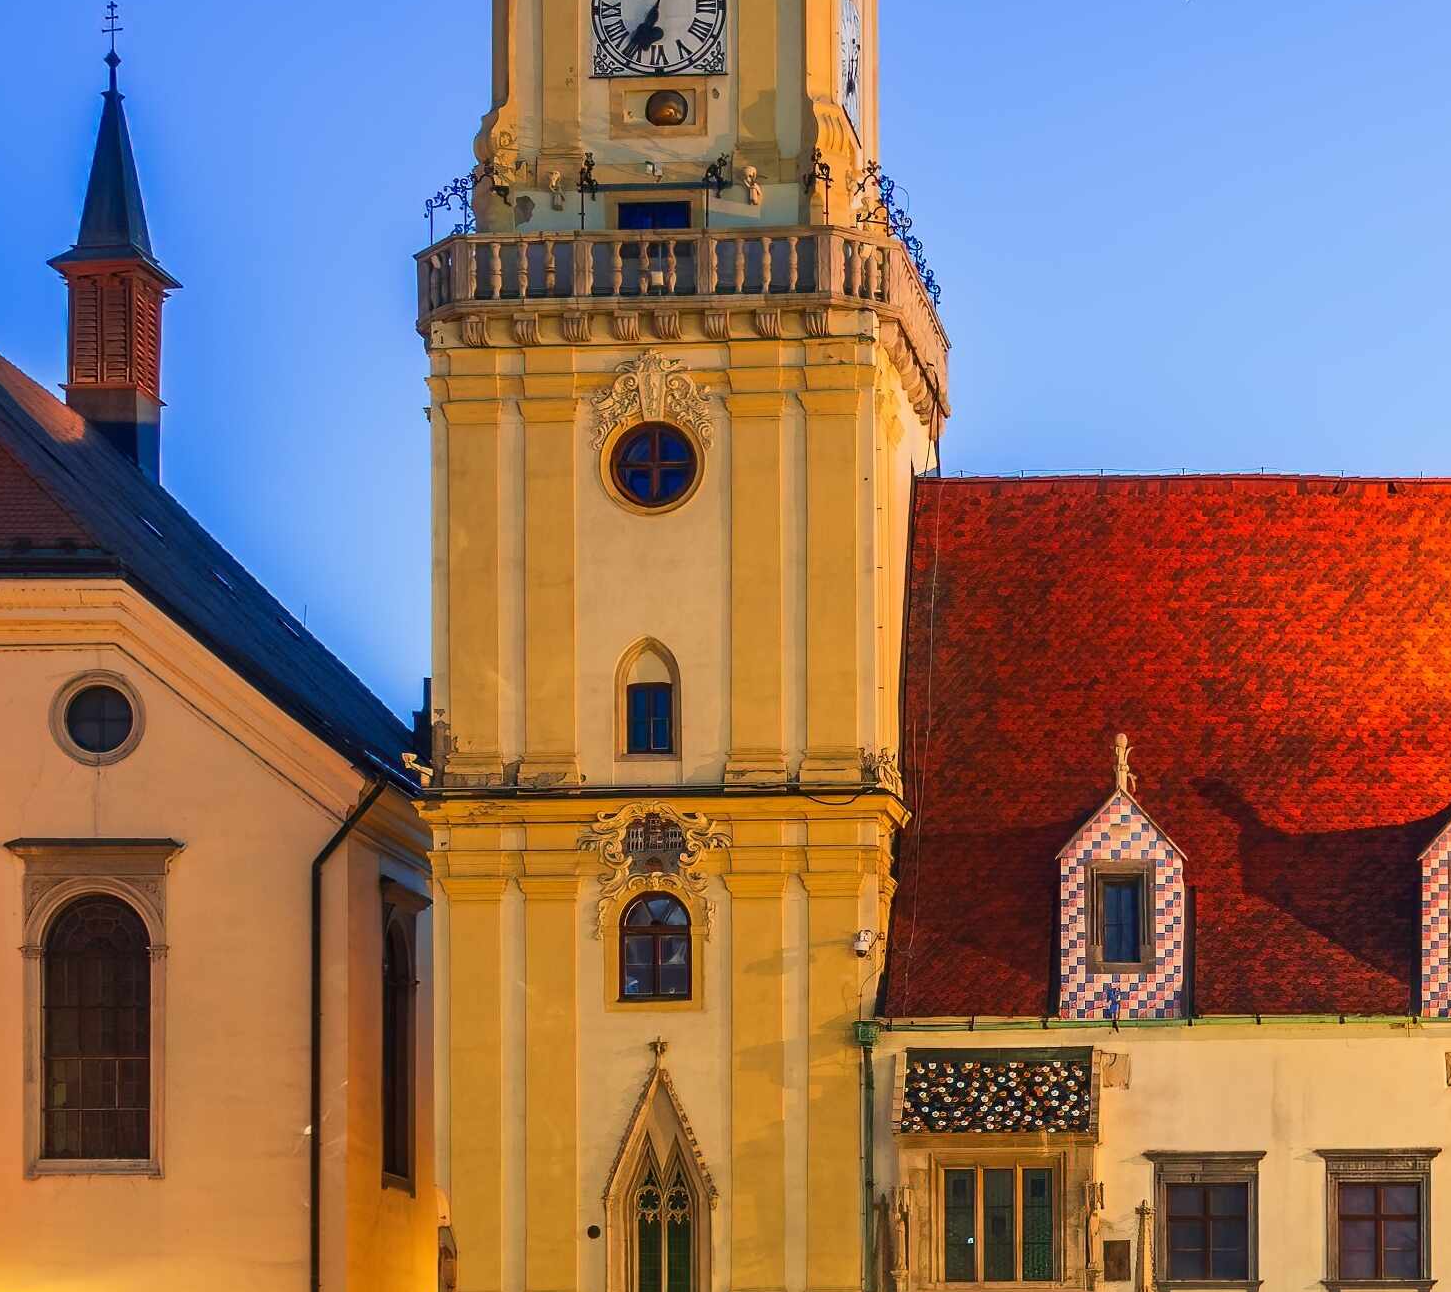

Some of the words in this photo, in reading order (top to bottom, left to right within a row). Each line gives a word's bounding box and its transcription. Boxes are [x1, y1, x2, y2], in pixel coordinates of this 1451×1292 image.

[602, 1, 621, 19] IX
[604, 19, 630, 49] VIII
[688, 17, 714, 44] IIII
[650, 44, 669, 65] VI
[676, 39, 694, 60] V
